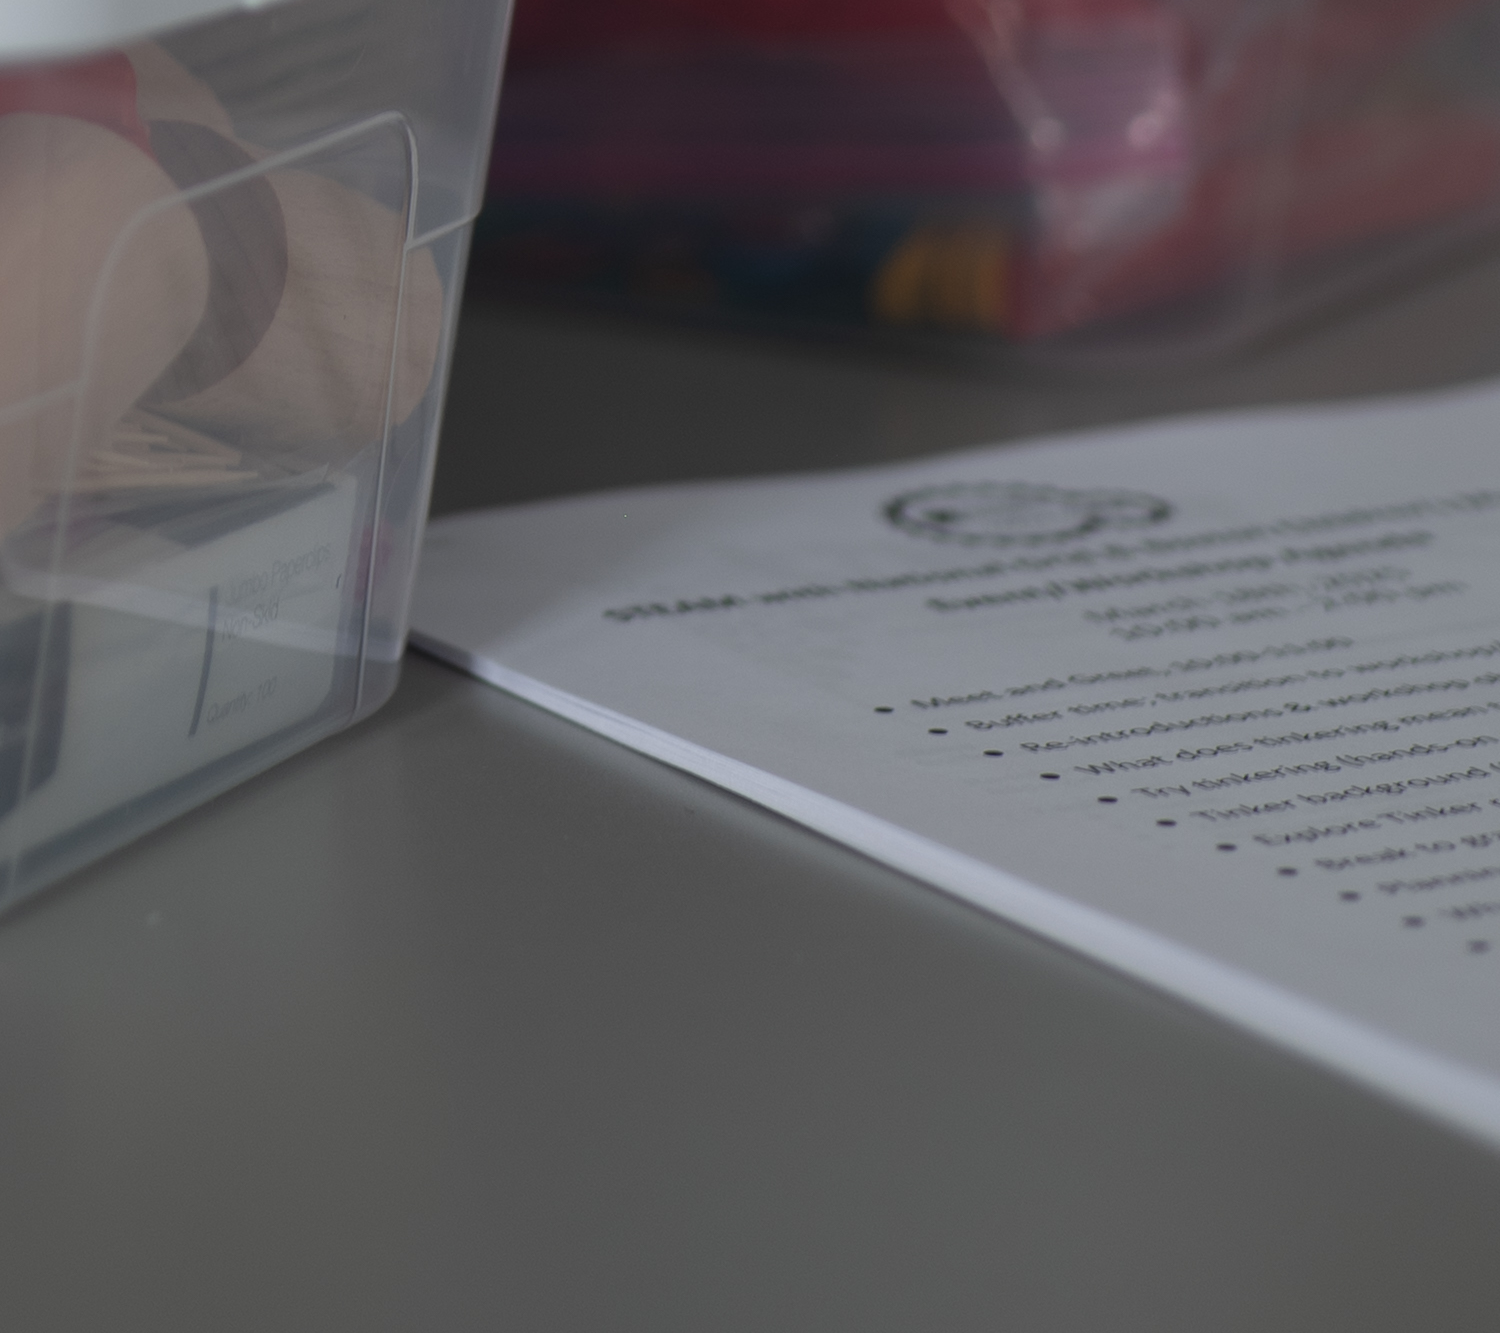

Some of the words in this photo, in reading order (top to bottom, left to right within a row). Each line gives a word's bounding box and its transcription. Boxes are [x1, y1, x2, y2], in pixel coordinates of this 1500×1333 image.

[971, 709, 1060, 731] Buffer
[1027, 705, 1277, 754] Re-introductions
[1285, 701, 1309, 713] &
[1077, 753, 1167, 776] What
[1168, 740, 1252, 761] does
[1255, 718, 1398, 750] tinkering
[1396, 703, 1488, 725] mean
[1138, 782, 1191, 800] Try
[1192, 759, 1340, 792] tinkering
[1336, 732, 1499, 768] (hands-on
[1194, 798, 1299, 822] Tinker
[1301, 766, 1491, 807] background
[1255, 817, 1384, 848] Explore
[1384, 800, 1484, 824] Tinker
[1312, 845, 1409, 869] Break
[1410, 838, 1454, 853] to
